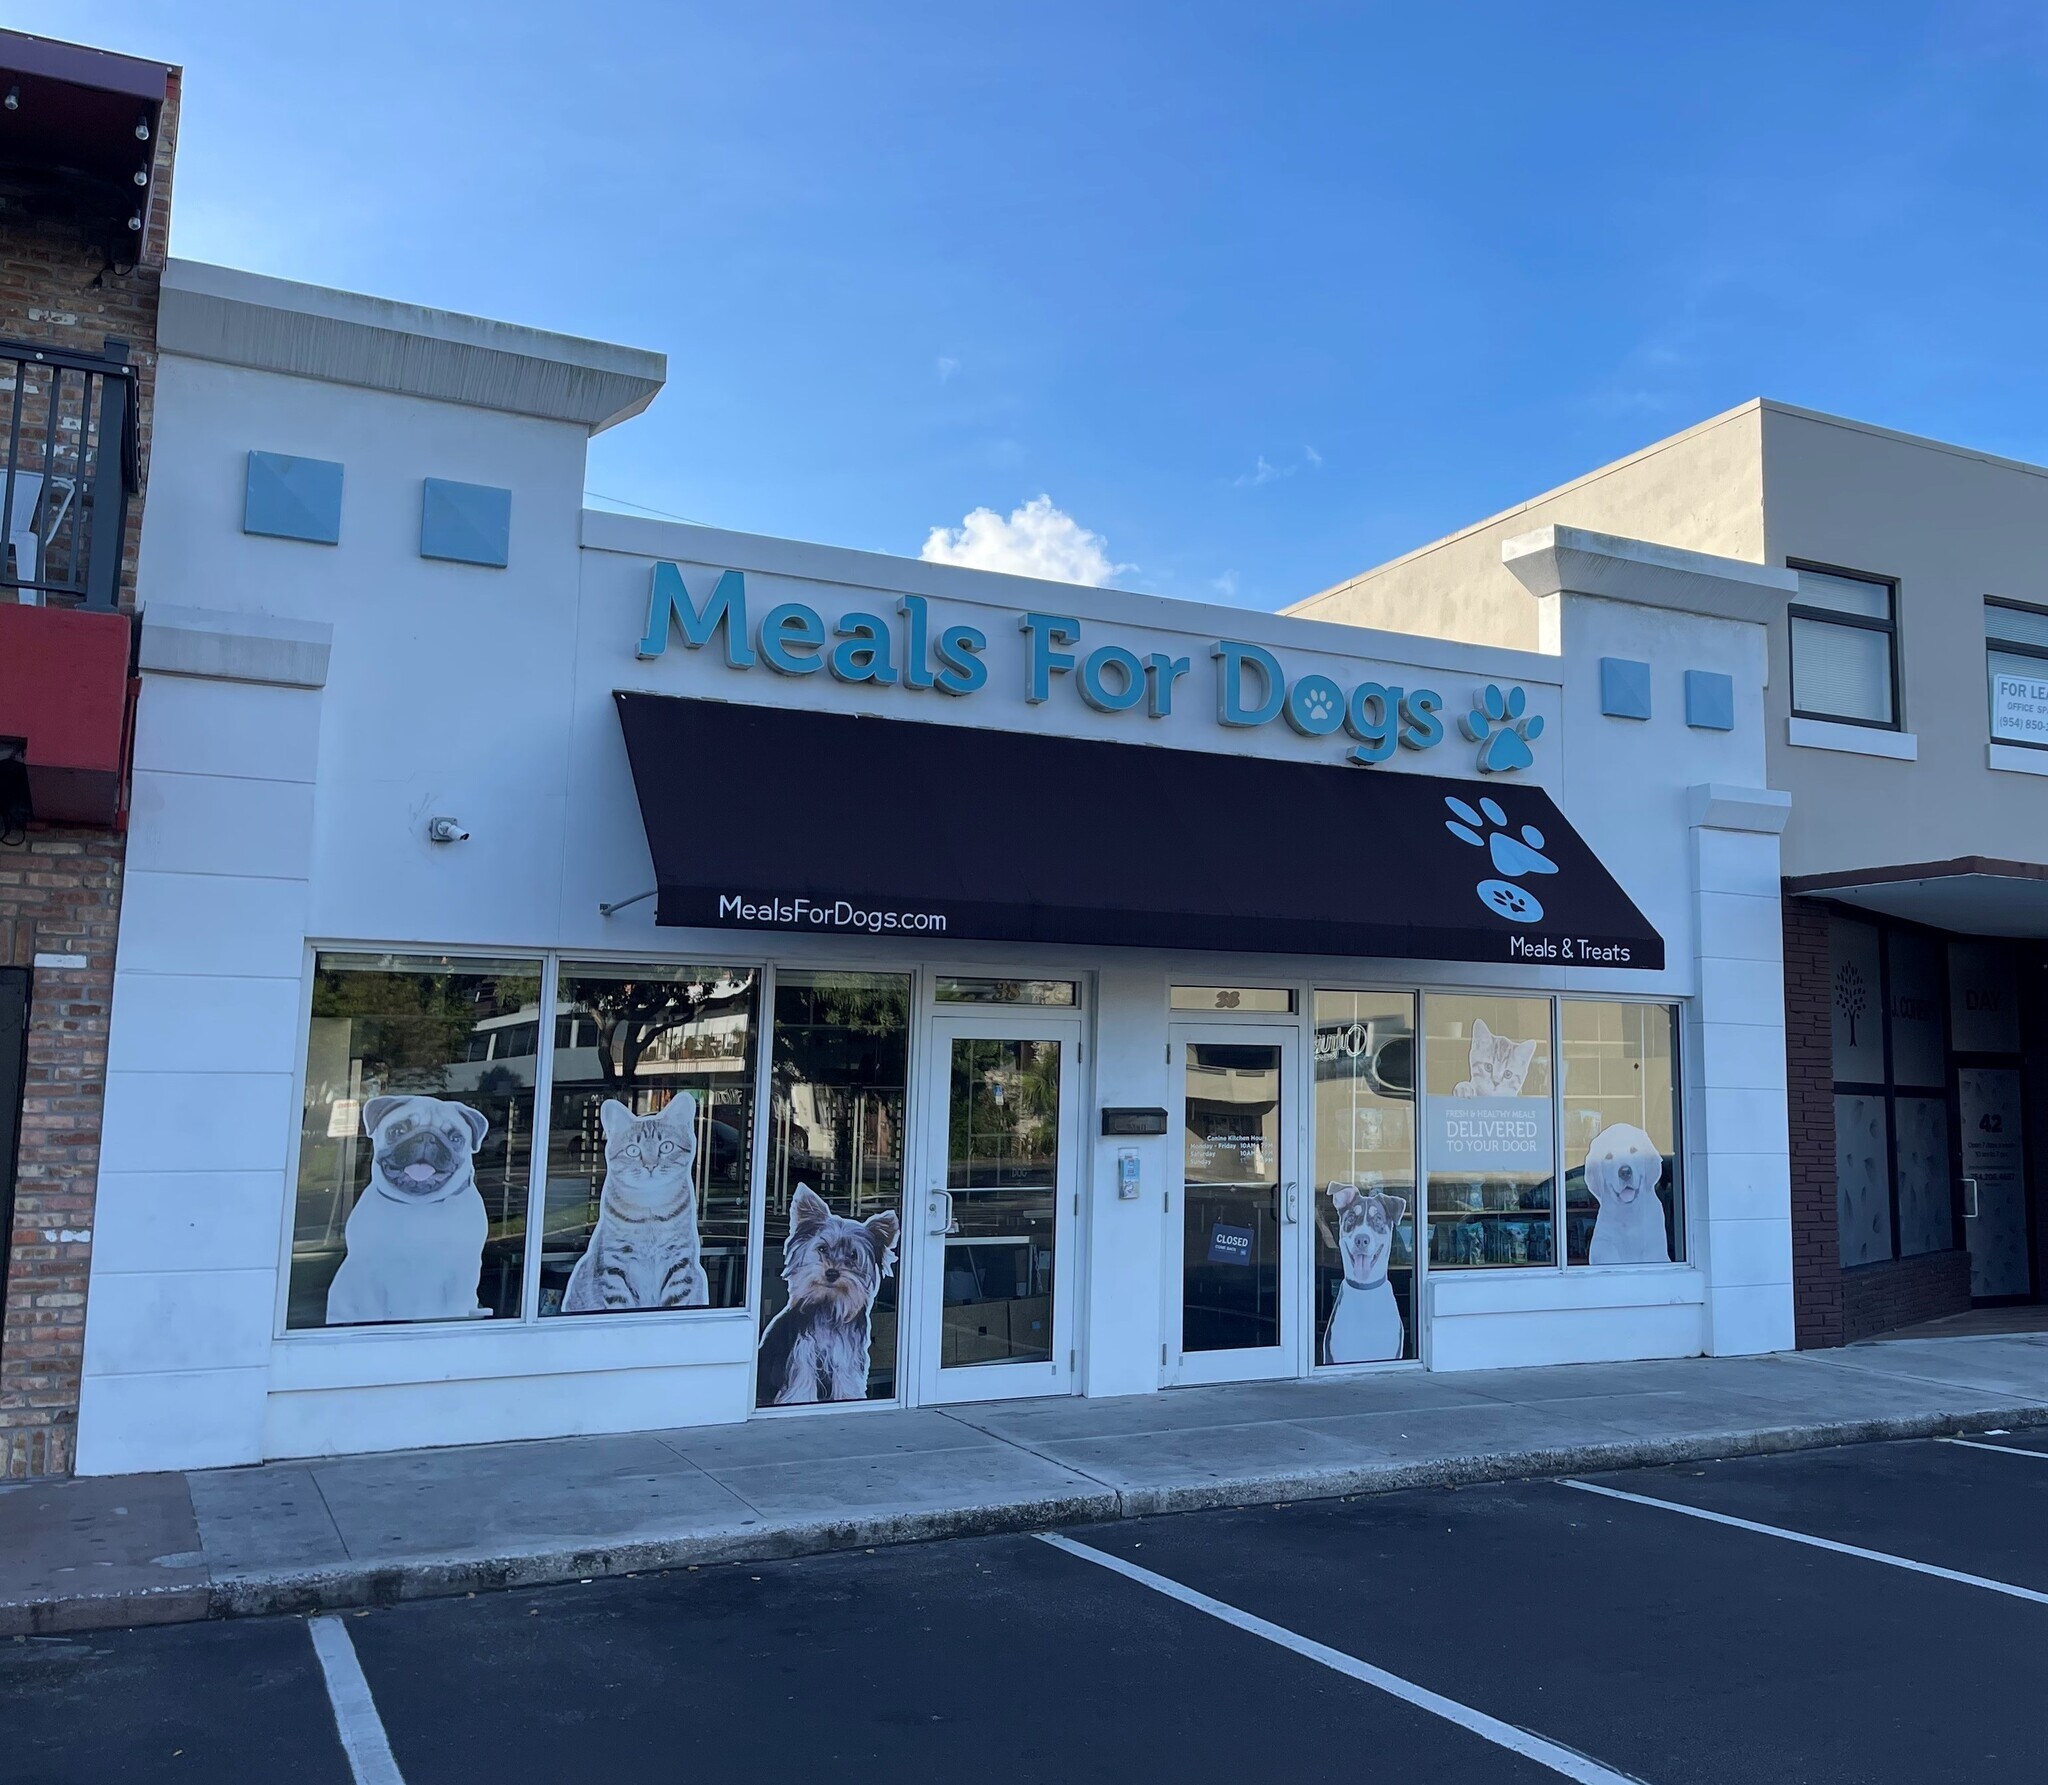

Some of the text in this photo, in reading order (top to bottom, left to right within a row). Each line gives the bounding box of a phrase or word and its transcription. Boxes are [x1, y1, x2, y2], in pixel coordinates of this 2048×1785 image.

[635, 561, 1444, 765] Meals For Dogs
[2001, 682, 2048, 701] FOR LE
[2007, 702, 2048, 715] OFFICE SP
[2000, 716, 2023, 730] (954)
[719, 894, 947, 932] MealsForDogs.com
[1510, 936, 1631, 962] Meals & Treats
[1965, 988, 2000, 1012] DAY
[1446, 1109, 1468, 1118] FRESH
[1477, 1110, 1511, 1118] HEALTHY
[1512, 1110, 1536, 1119] MEALS
[1979, 1113, 2003, 1133] 42
[1446, 1121, 1537, 1138] DELIVERED
[1446, 1140, 1537, 1152] TO YOUR DOOR
[1216, 1233, 1248, 1247] CLOSED
